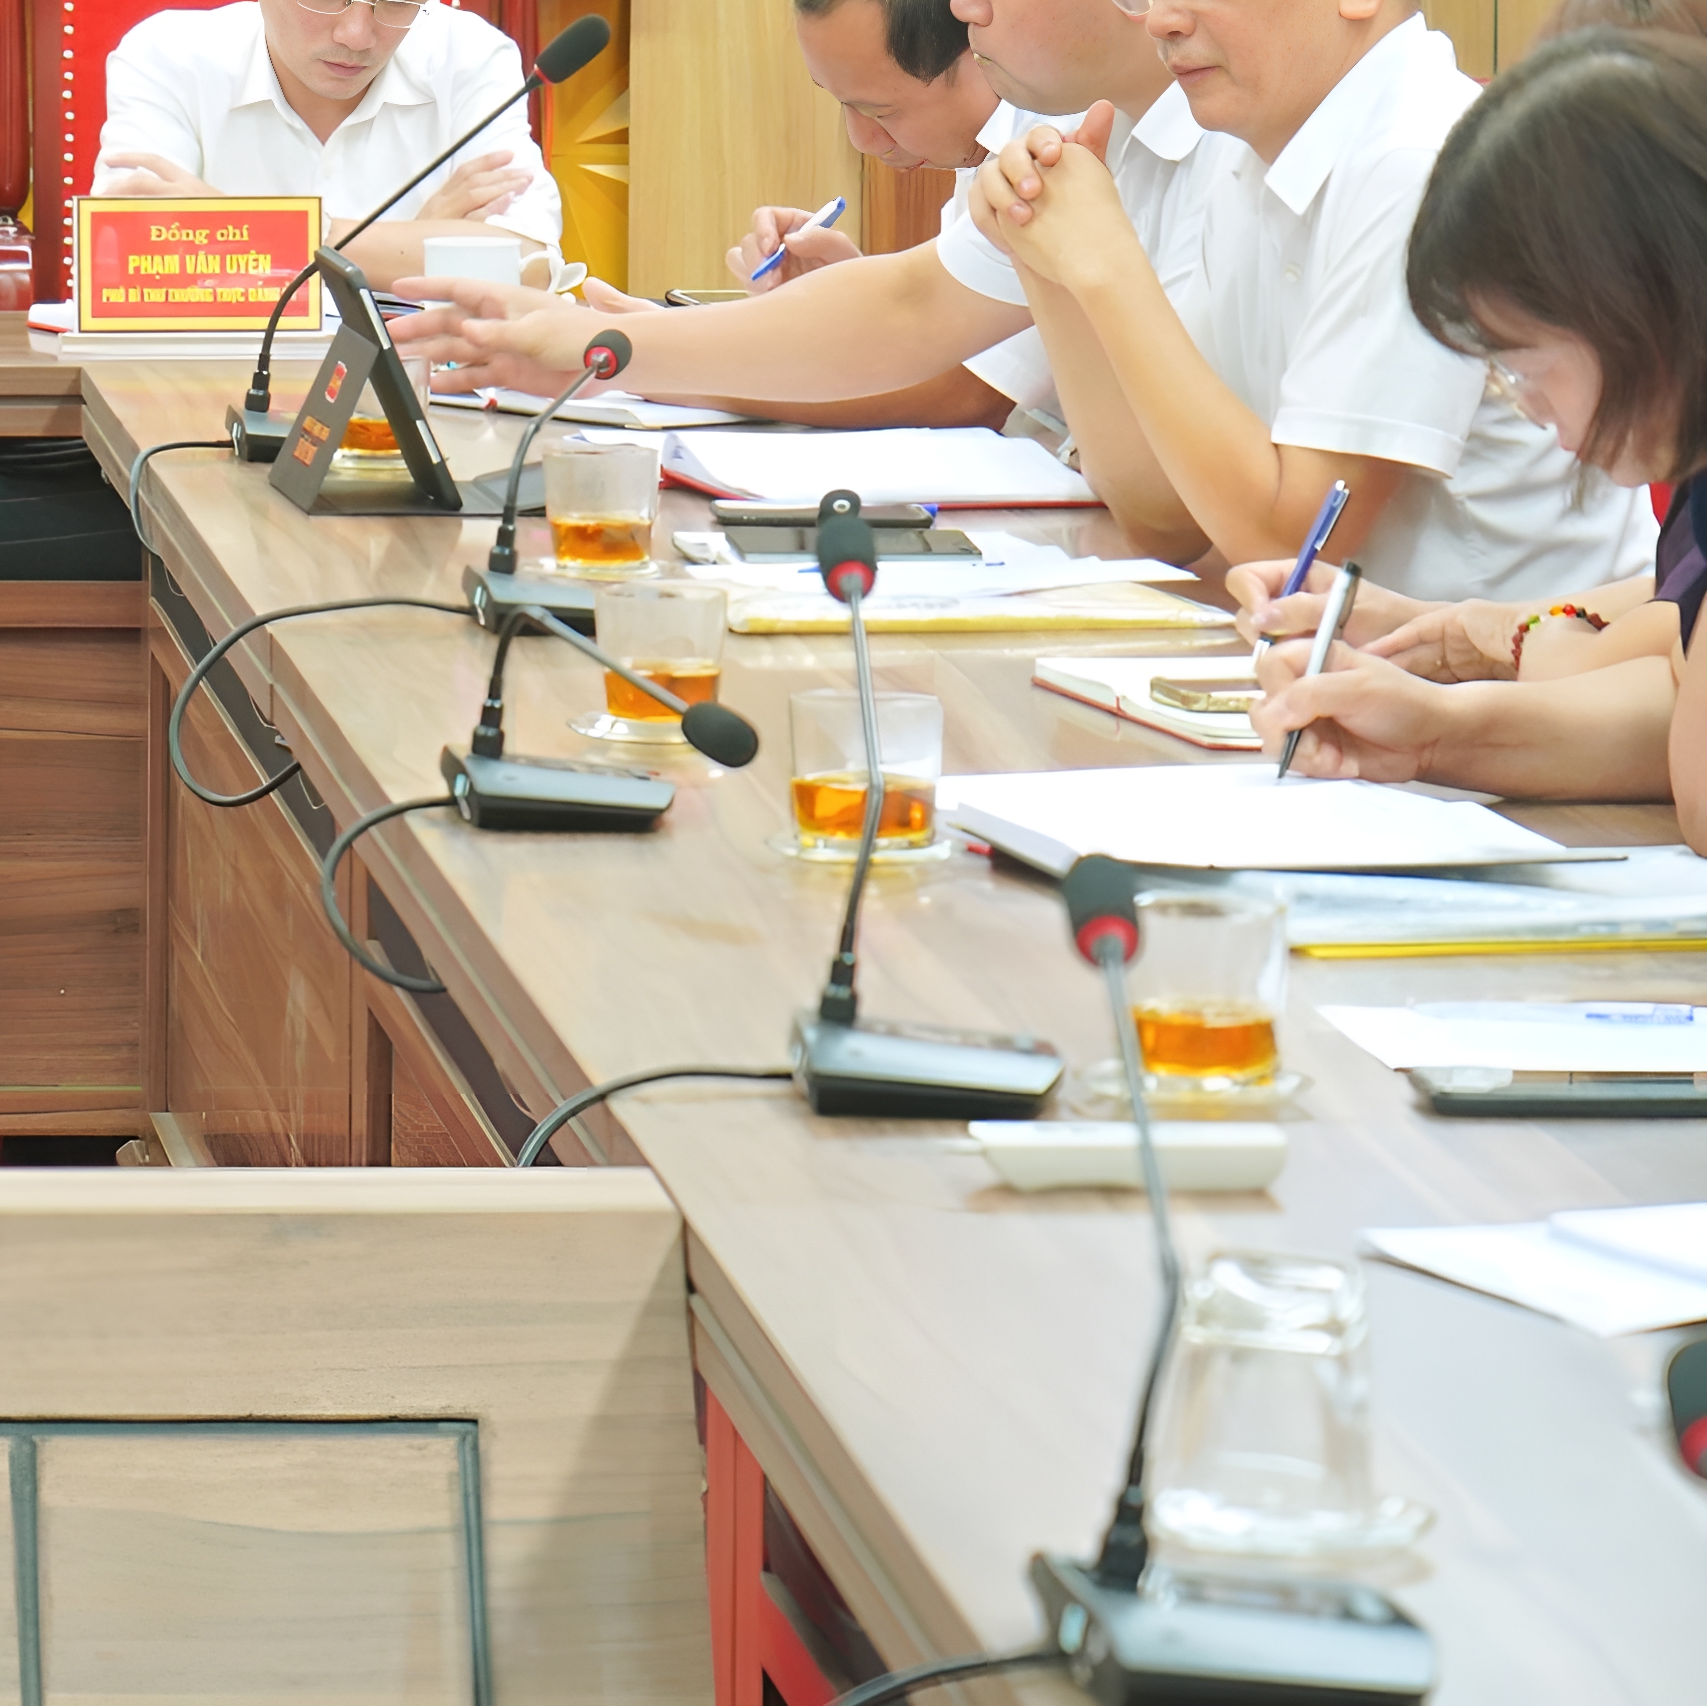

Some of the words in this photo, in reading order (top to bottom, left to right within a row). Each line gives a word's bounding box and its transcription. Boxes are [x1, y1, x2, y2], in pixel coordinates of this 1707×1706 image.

[216, 224, 249, 241] chí
[128, 254, 180, 280] PHẠM
[185, 251, 221, 275] VĂN
[226, 250, 272, 275] UYÊN
